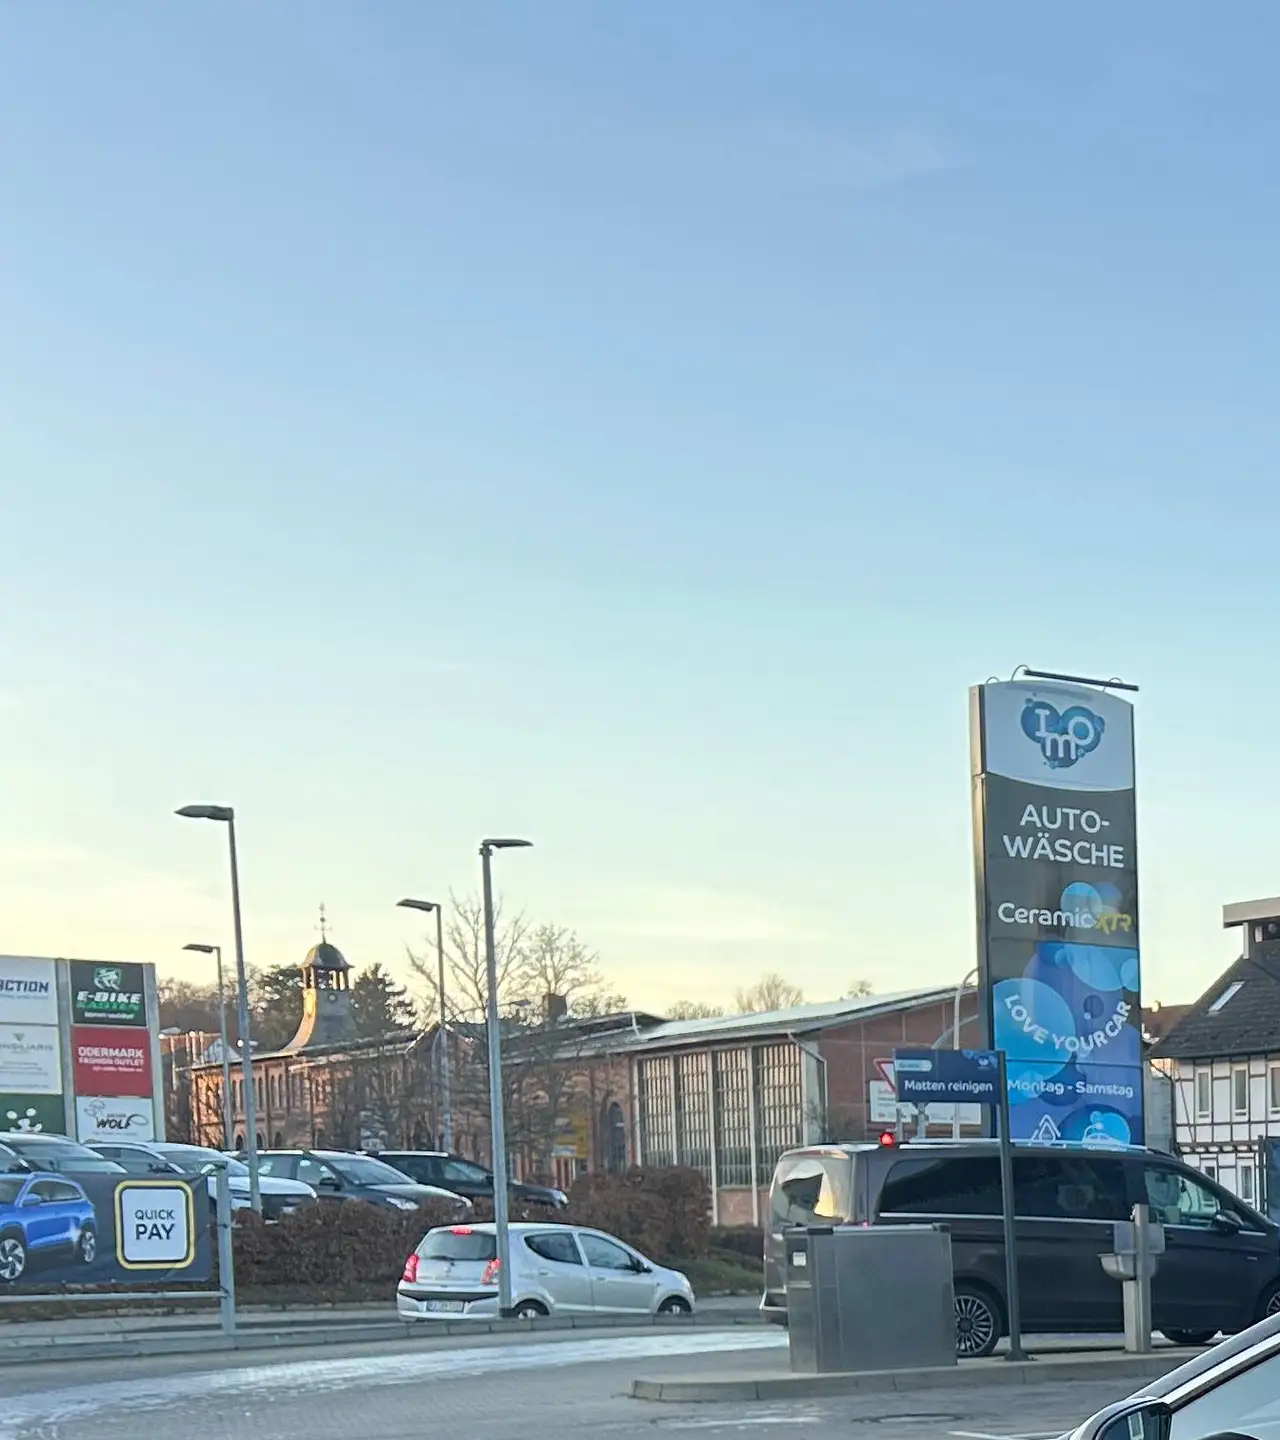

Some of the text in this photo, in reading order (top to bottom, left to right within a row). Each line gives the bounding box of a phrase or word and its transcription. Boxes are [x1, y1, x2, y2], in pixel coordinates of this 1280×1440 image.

[1020, 804, 1110, 834] AUTO-
[1002, 832, 1125, 869] WÄSCHE
[1004, 994, 1132, 1055] LOVE YOUR CAR
[78, 1046, 144, 1059] ODERMARK
[904, 1079, 993, 1094] Matten reinigen
[1008, 1078, 1064, 1096] Montag
[1075, 1080, 1135, 1098] Samstag
[134, 1209, 175, 1220] QUICK
[135, 1223, 175, 1240] PAY
